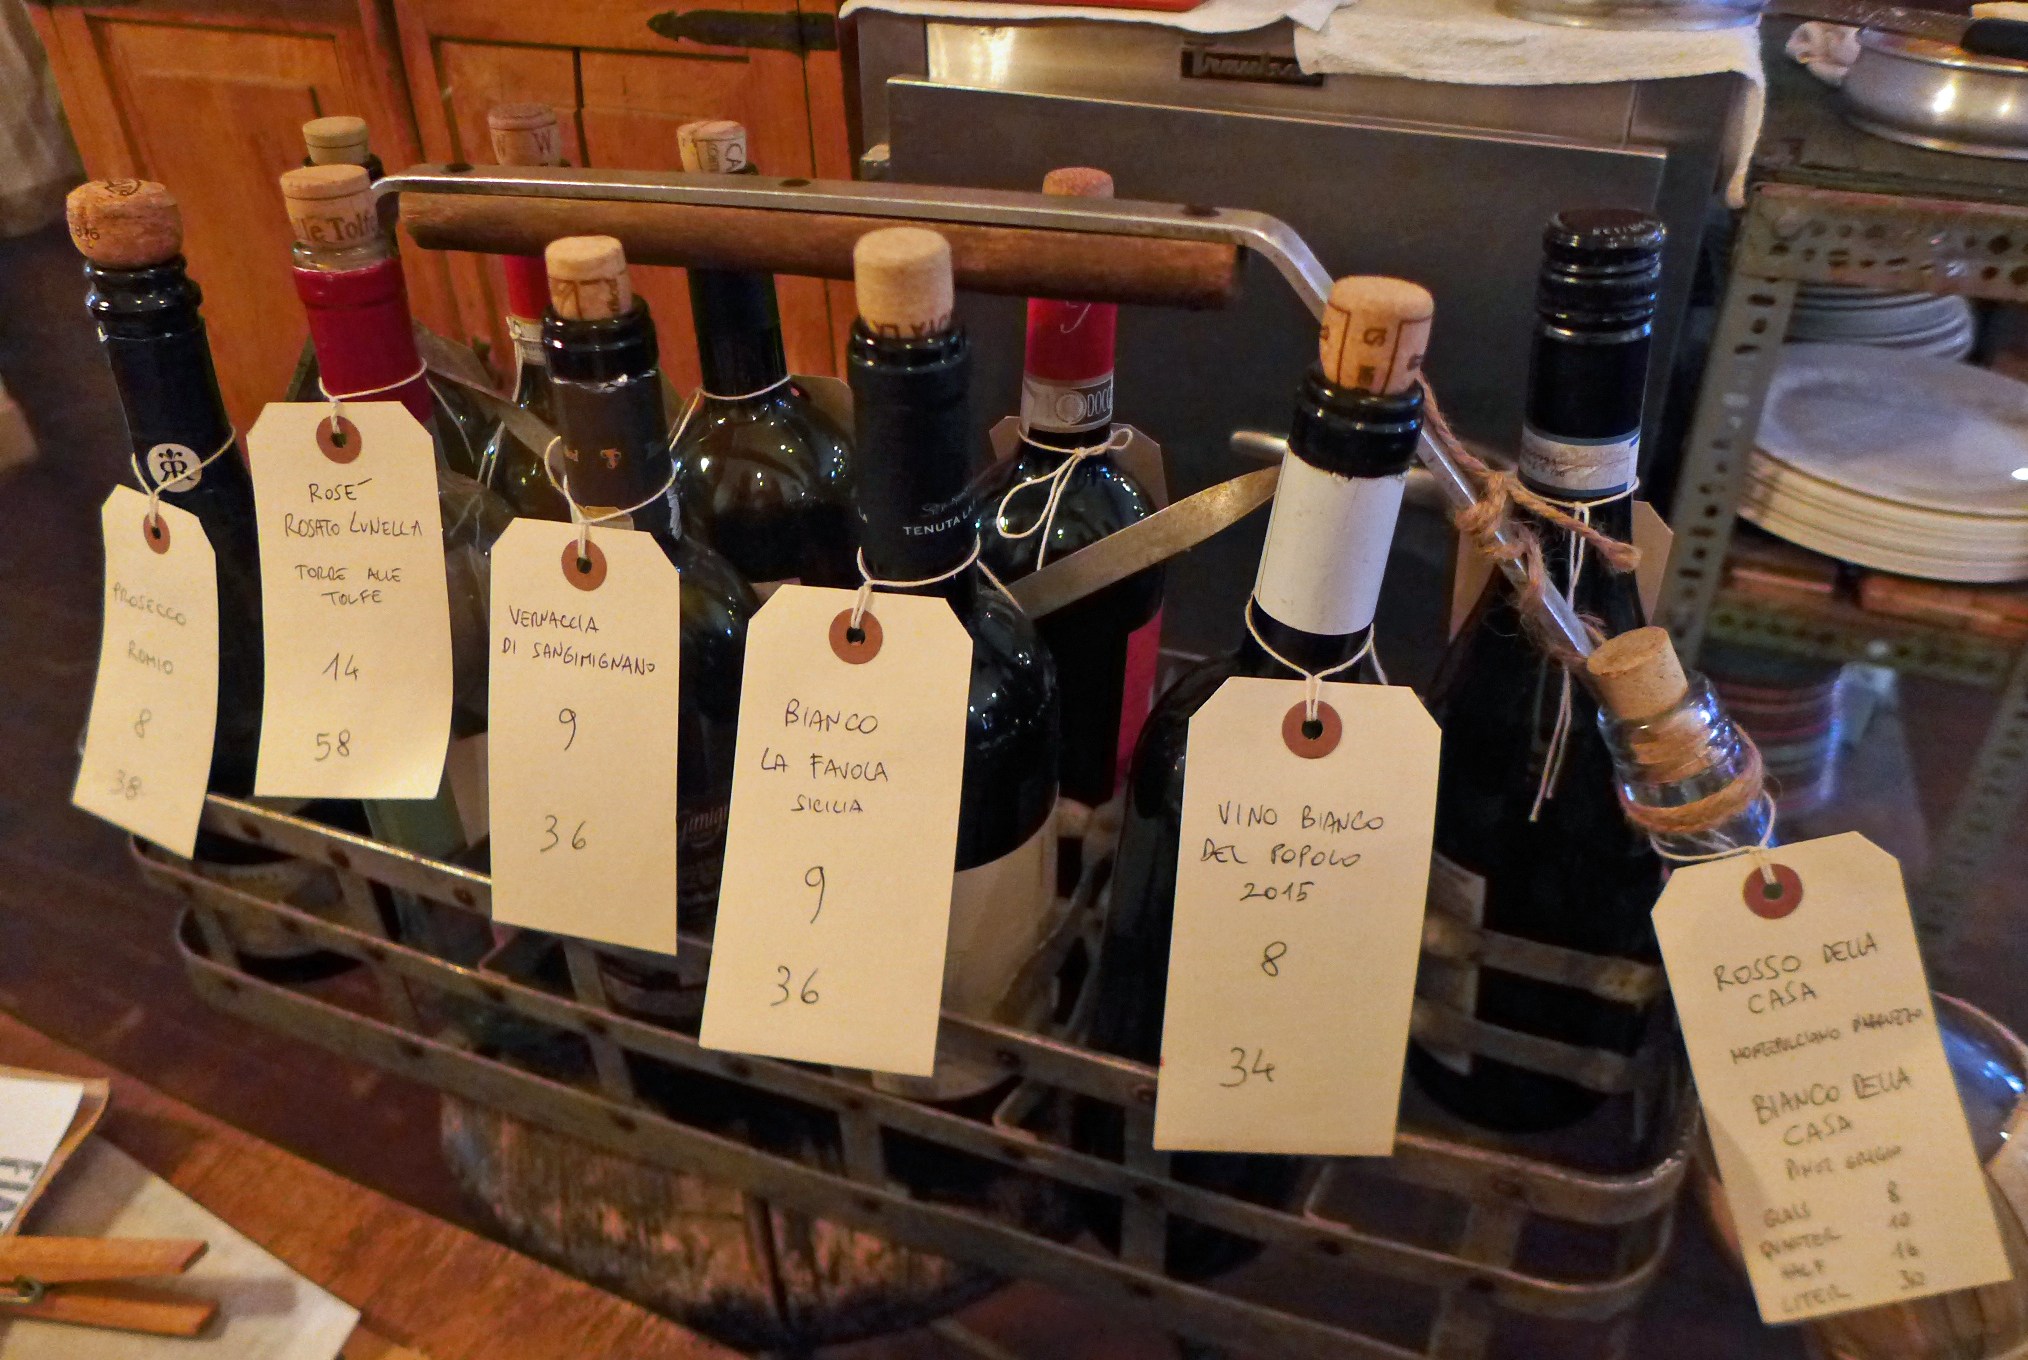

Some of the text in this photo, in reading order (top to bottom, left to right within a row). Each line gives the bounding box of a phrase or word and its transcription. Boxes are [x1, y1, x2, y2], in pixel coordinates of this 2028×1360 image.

[285, 511, 423, 537] ROSATO LUNELLA
[902, 515, 961, 536] TENUTA
[295, 564, 402, 582] TORRE ALLE
[113, 582, 187, 627] PROSECCO
[321, 590, 383, 606] TOLFE
[509, 605, 599, 633] VERNACCIA
[322, 653, 360, 681] 14
[502, 637, 655, 676] DI SANGIMIGNANO
[134, 708, 152, 738] 8
[558, 708, 577, 751] 9
[785, 698, 878, 734] BIANCO
[314, 729, 351, 761] 58
[761, 747, 889, 783] LA FAVOLA
[113, 770, 144, 800] 38
[790, 794, 864, 814] SICILIA
[1218, 801, 1385, 831] VINO BIANCO
[540, 815, 587, 852] 36
[1200, 839, 1361, 868] DEL POPOLO
[804, 865, 826, 924] 9
[1239, 881, 1315, 902] 2015
[1261, 941, 1287, 977] 8
[1713, 932, 1878, 991] ROSSO DELLA
[770, 965, 820, 1007] 36
[1748, 982, 1818, 1014] CASA
[1219, 1047, 1276, 1088] 34
[1752, 1067, 1912, 1126] BIANCO DELLA
[1783, 1113, 1853, 1146] CASA
